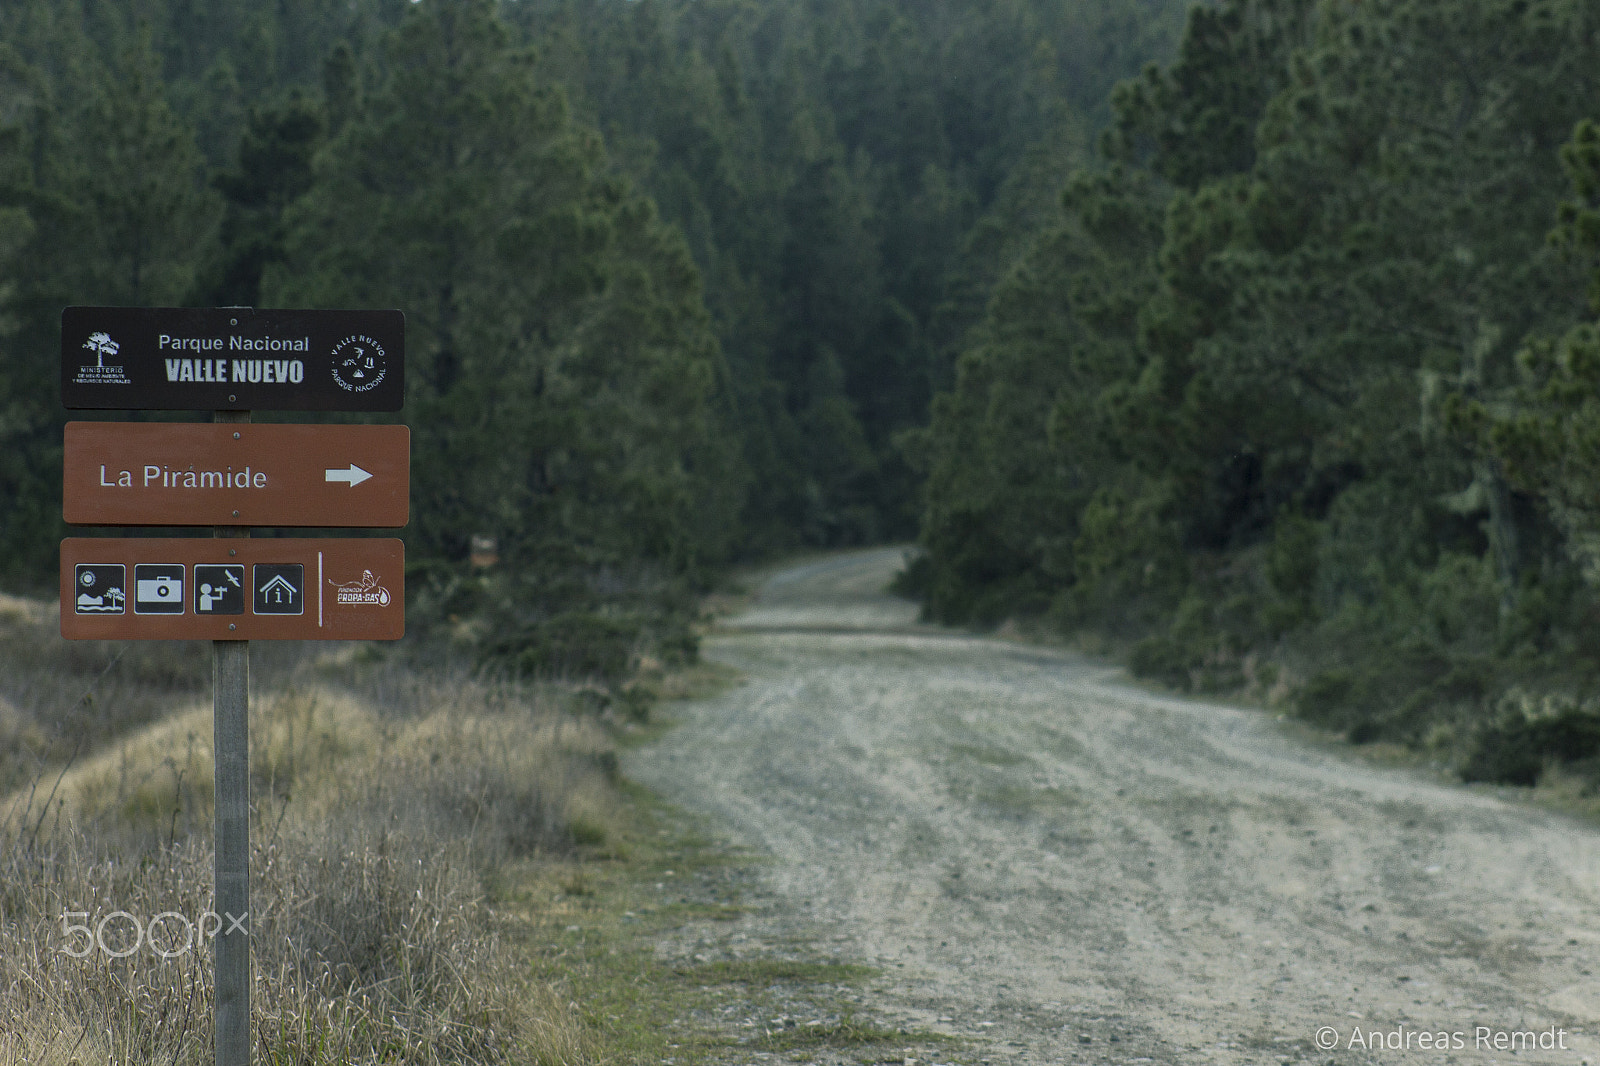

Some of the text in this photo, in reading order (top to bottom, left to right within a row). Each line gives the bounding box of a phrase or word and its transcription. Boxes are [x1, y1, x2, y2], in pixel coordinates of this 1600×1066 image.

[158, 334, 309, 353] Parque Nacional
[331, 334, 385, 356] VALLE NUEVO
[165, 358, 304, 383] VALLE NUEVO
[331, 368, 386, 392] PARQUE NACIONAL
[100, 464, 267, 488] La Pirámide
[337, 593, 380, 602] PROPA-GAS
